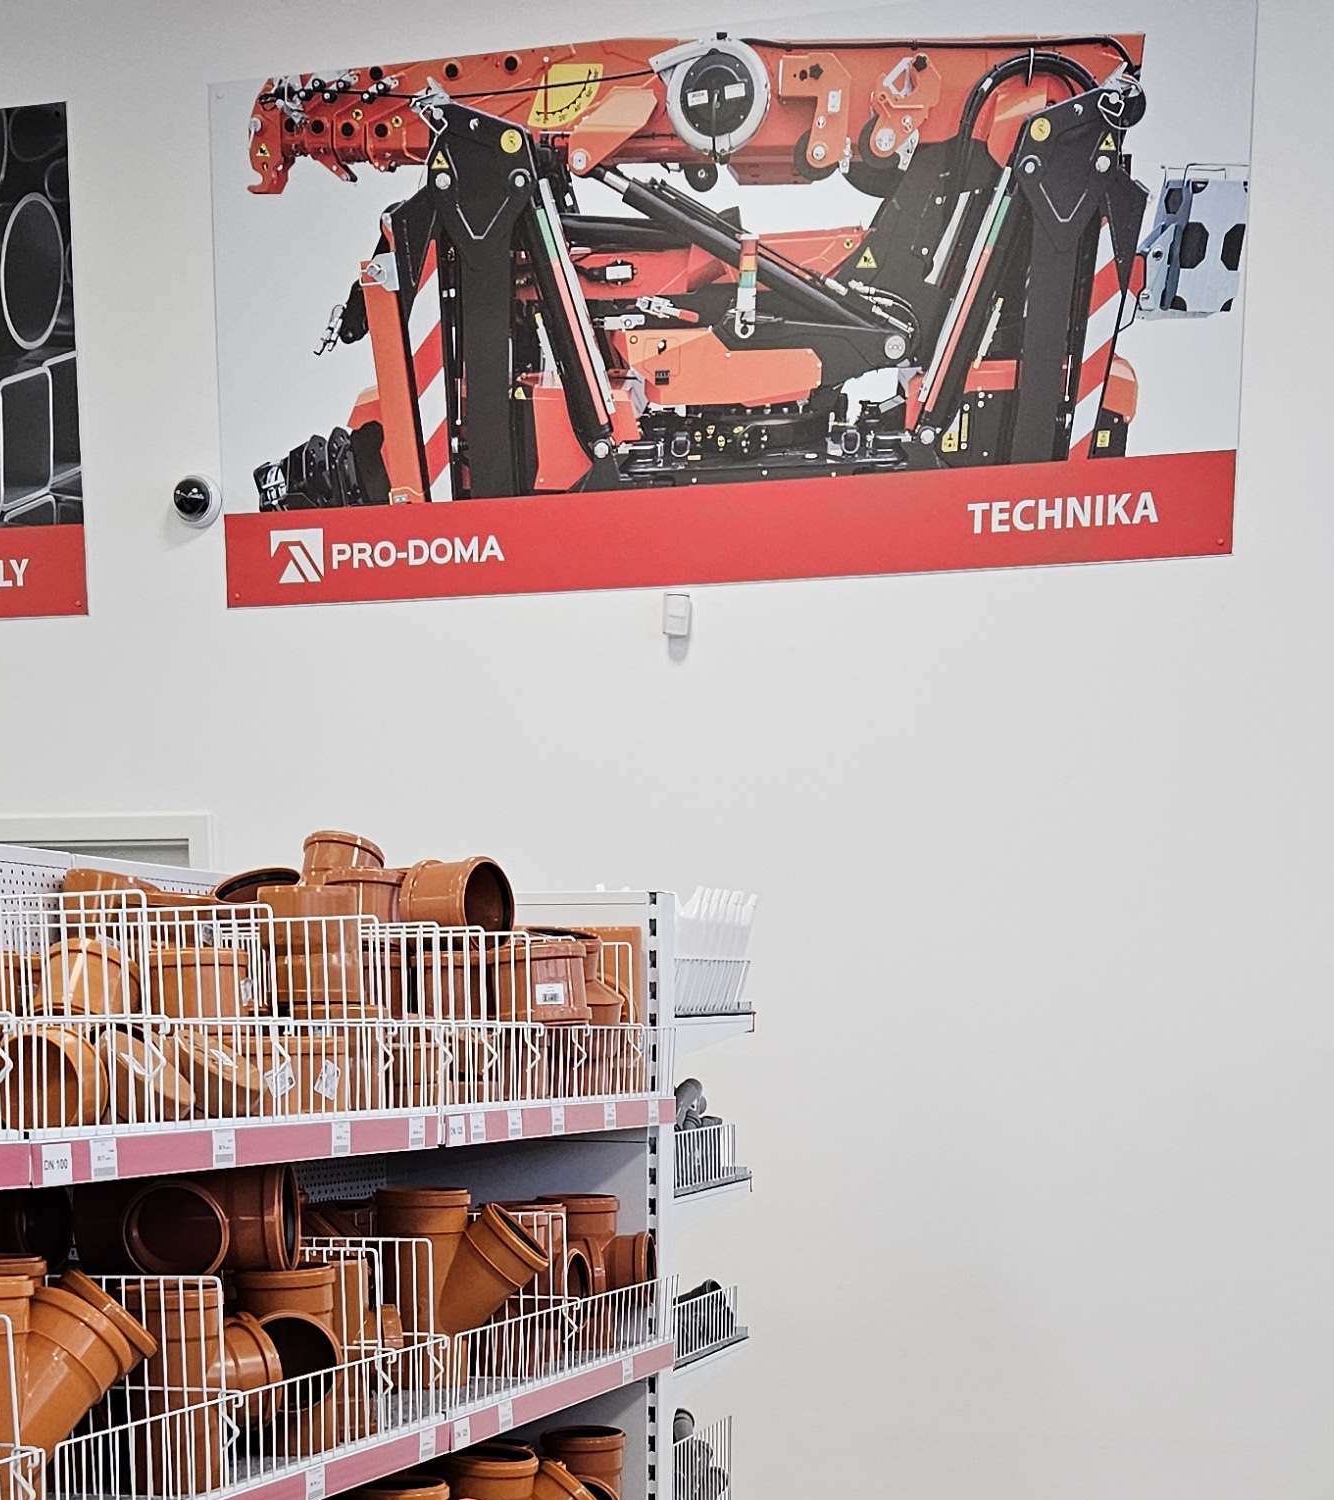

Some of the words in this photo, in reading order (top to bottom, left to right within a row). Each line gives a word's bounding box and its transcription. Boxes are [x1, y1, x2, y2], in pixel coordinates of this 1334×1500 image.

[967, 492, 1158, 534] TECHNIKA
[332, 535, 505, 569] PRO-DOMA
[44, 1159, 55, 1171] DN
[56, 1158, 68, 1170] 100
